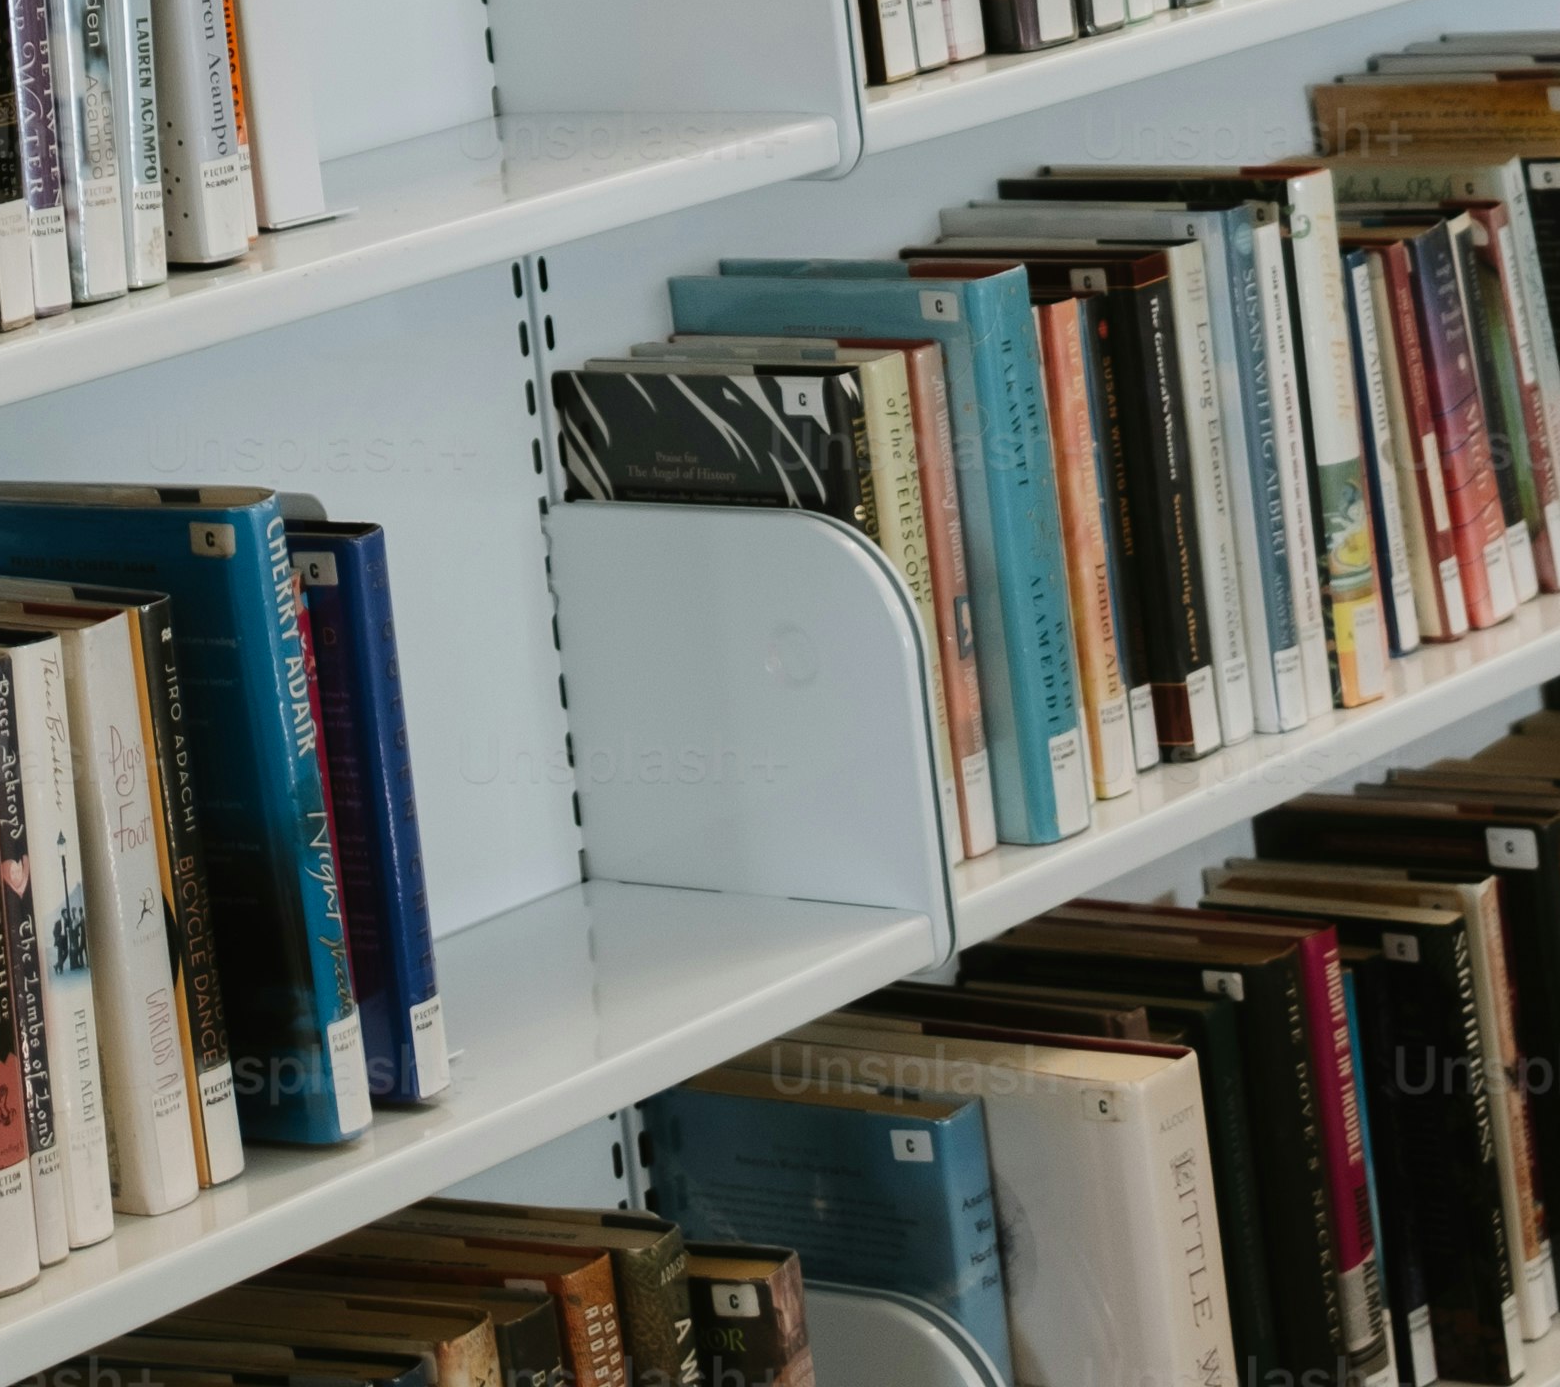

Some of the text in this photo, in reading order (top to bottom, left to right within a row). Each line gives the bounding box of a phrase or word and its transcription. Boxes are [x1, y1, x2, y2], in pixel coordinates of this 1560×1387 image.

[135, 17, 152, 88] LAUREN
[265, 514, 316, 758] CHERRY ADAIR
[163, 663, 197, 834] JIRO ADACHI
